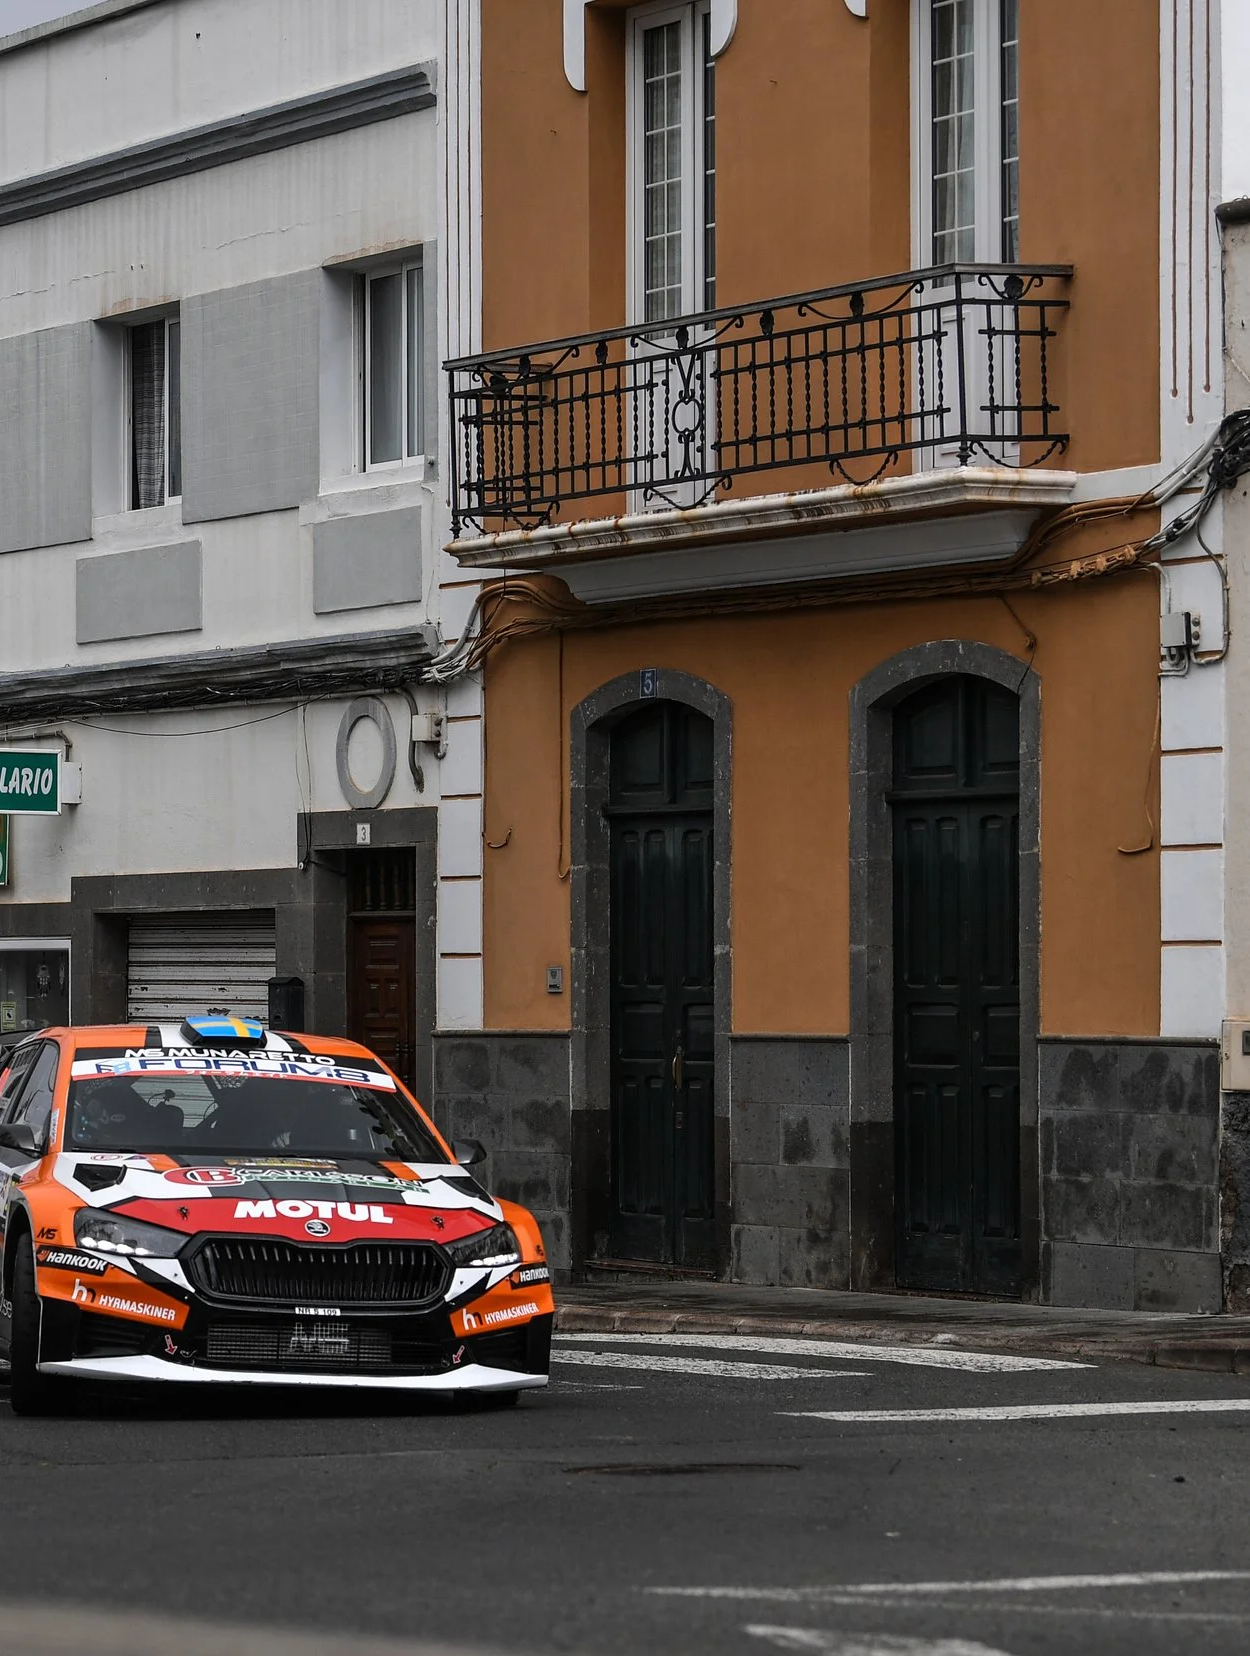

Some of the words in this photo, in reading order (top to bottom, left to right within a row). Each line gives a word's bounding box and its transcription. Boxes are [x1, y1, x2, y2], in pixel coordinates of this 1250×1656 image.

[643, 672, 653, 694] 5
[361, 825, 367, 842] 3
[168, 1048, 336, 1066] MUNARETTO
[138, 1059, 370, 1083] FORUM8
[234, 1199, 394, 1224] MOTUL
[99, 1294, 176, 1321] HYRMASKINER
[484, 1302, 540, 1325] HYRMASKINER
